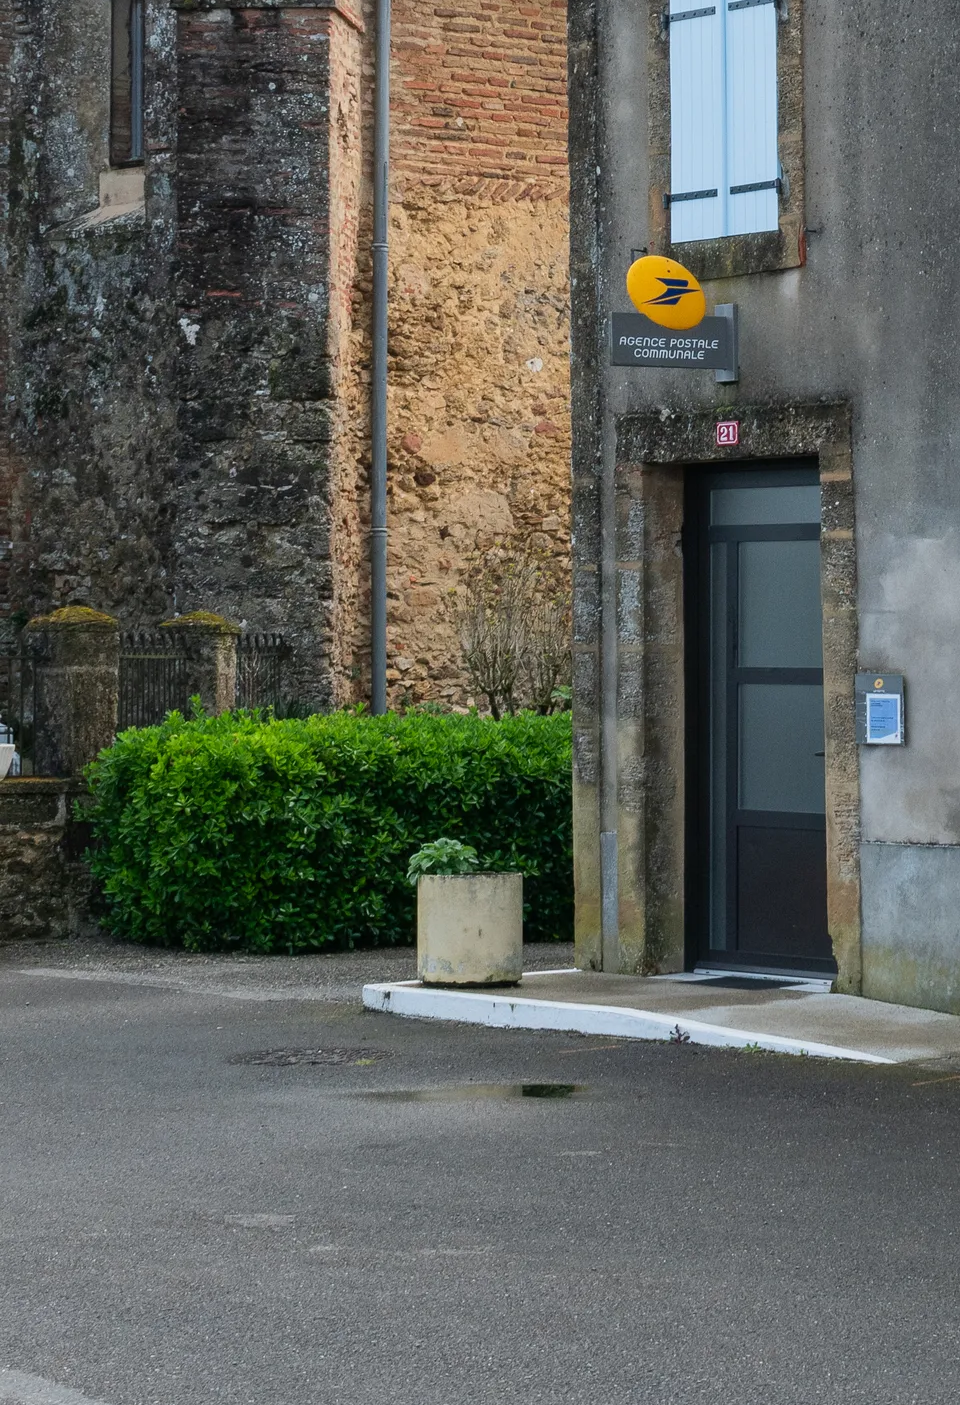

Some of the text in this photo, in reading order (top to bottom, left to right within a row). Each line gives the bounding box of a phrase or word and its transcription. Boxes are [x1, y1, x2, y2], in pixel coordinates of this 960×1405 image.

[619, 336, 719, 349] AGENCE POSTALE
[633, 348, 705, 360] COMMUNALE
[720, 425, 734, 441] 21
